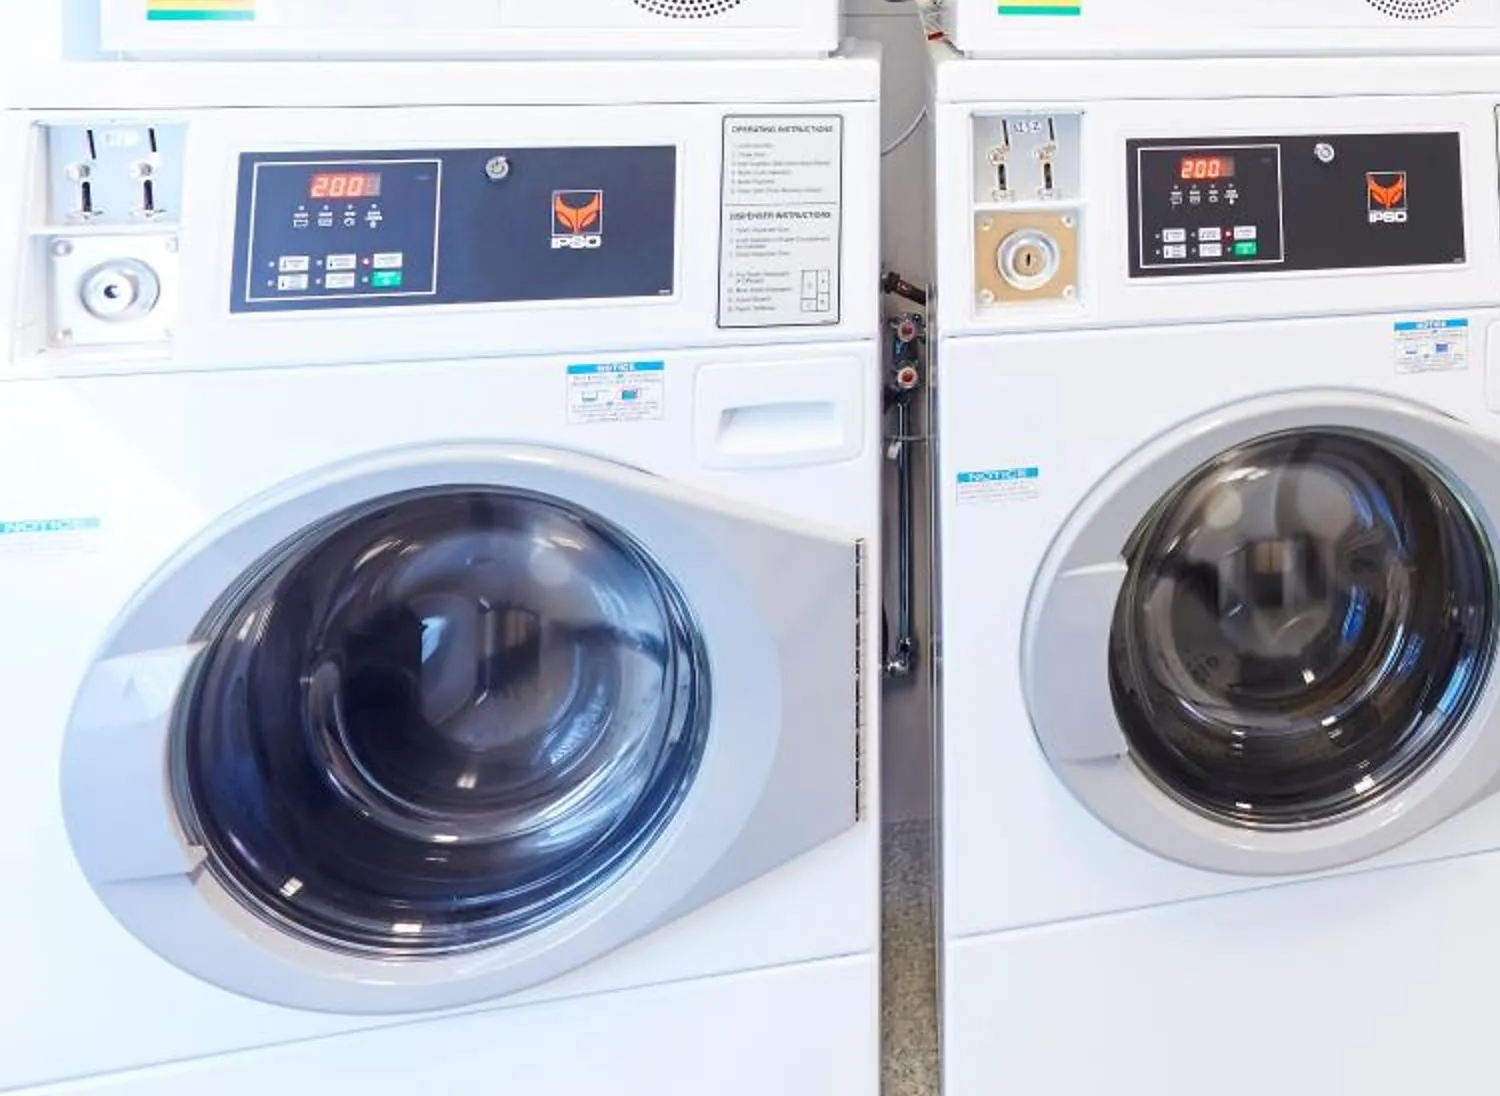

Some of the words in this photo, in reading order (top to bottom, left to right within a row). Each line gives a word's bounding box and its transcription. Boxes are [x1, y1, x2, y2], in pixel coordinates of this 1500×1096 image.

[1181, 158, 1220, 179] 200
[310, 175, 364, 198] 200
[1368, 211, 1408, 223] IPSO
[550, 235, 602, 249] IPSO
[969, 468, 1025, 483] NOTICE
[4, 519, 79, 533] NOTICE
